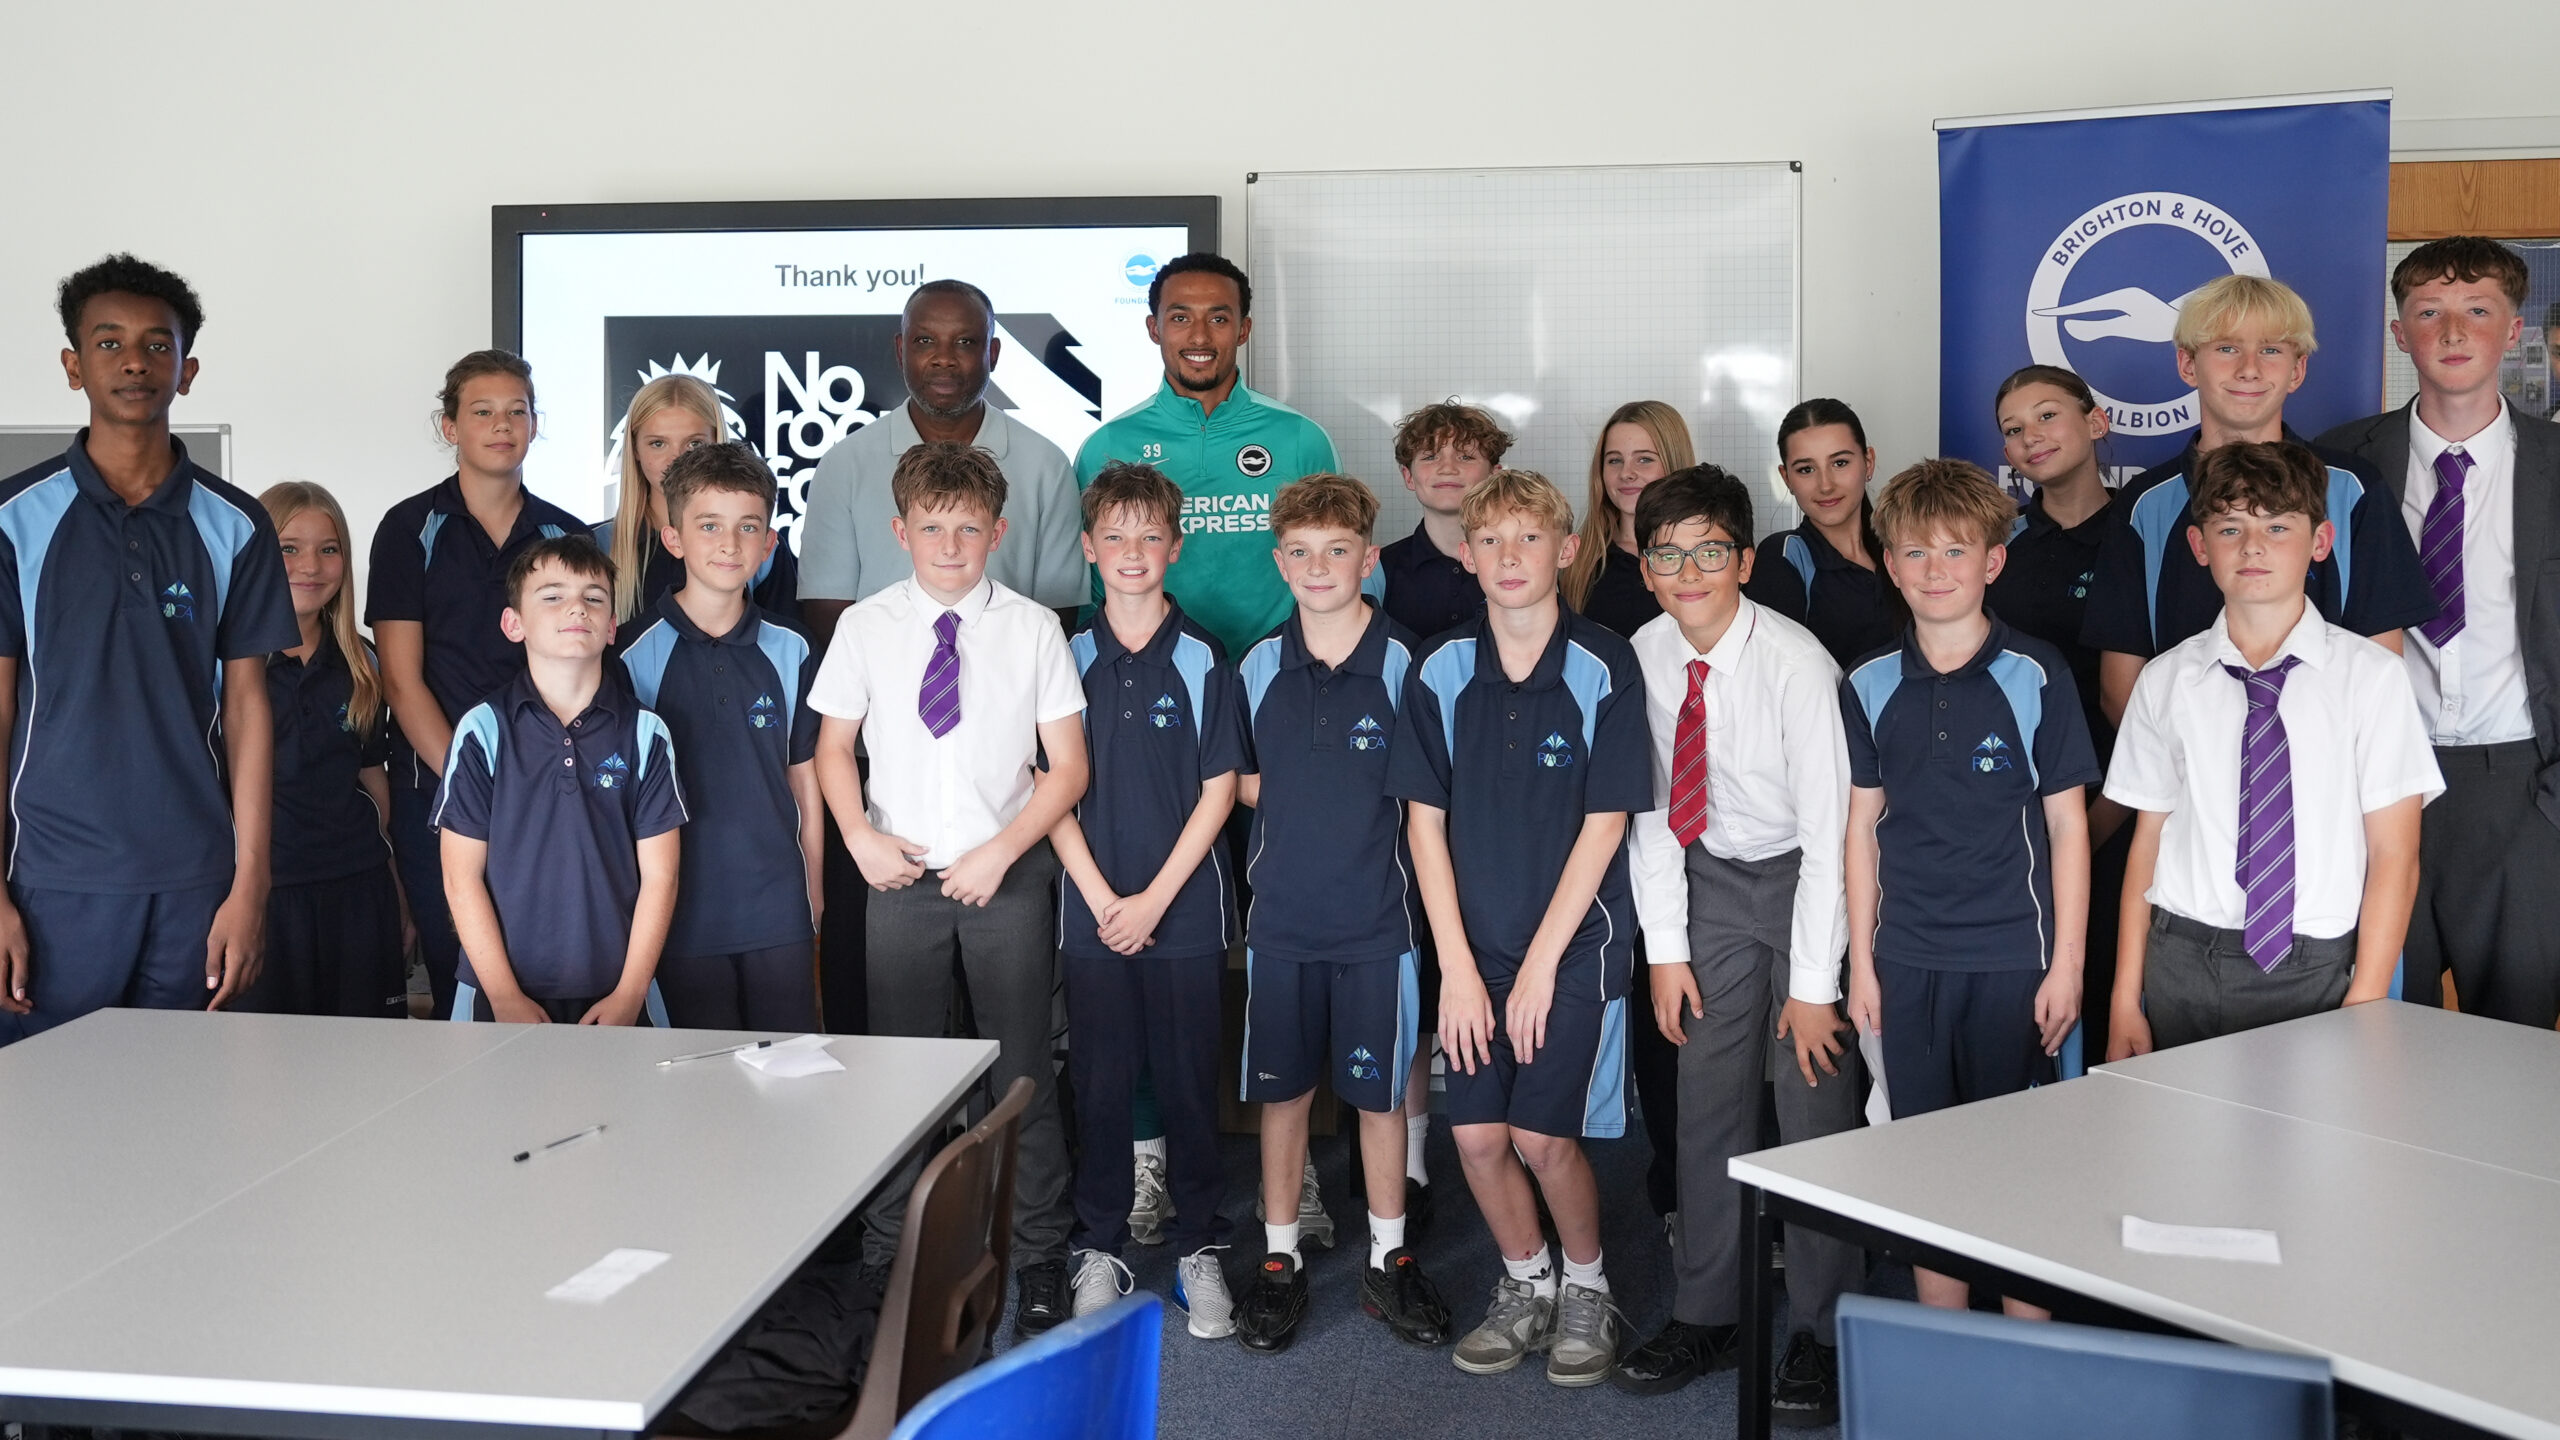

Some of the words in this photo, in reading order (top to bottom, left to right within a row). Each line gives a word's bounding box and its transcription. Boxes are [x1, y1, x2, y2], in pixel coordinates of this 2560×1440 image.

[2052, 200, 2161, 267] BRIGHTON
[2171, 202, 2185, 219] &
[2193, 209, 2250, 258] HOVE
[775, 264, 858, 287] Thank
[866, 263, 925, 293] you!
[764, 351, 866, 415] No
[2104, 404, 2190, 428] ALBION
[1142, 443, 1162, 459] 39
[1180, 493, 1270, 514] ERICAN
[1179, 513, 1271, 535] XPRESS
